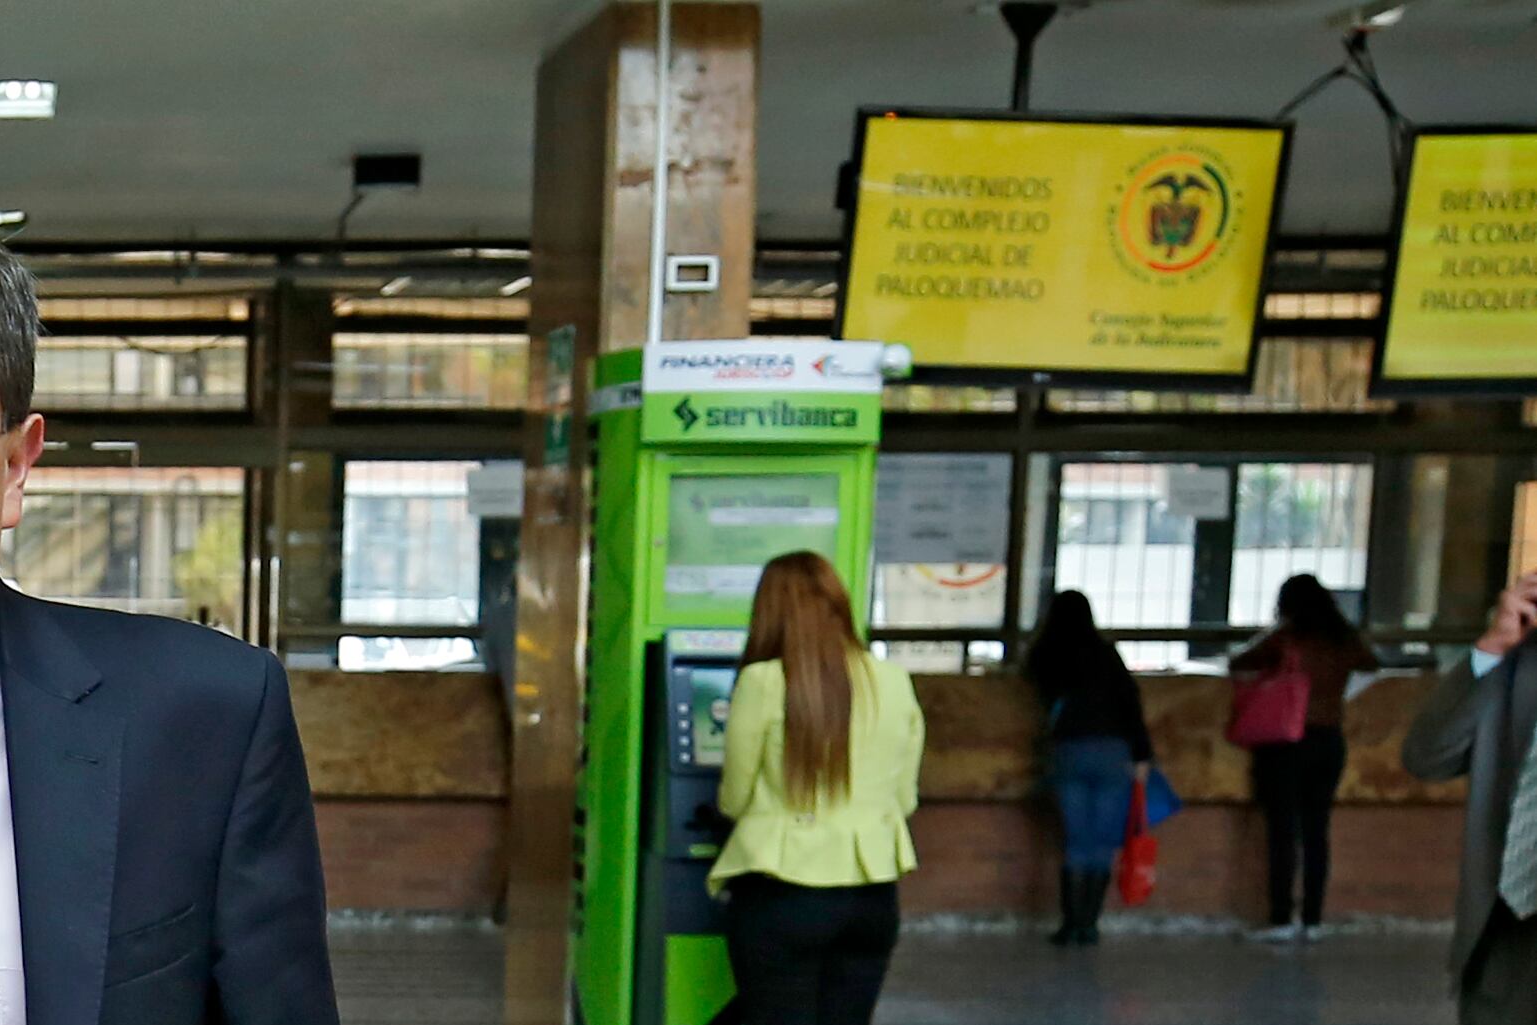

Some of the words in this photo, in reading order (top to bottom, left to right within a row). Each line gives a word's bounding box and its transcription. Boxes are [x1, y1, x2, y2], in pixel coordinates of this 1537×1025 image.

[893, 172, 1053, 200] BIENVENIDOS
[887, 208, 913, 231] AL
[921, 207, 1051, 233] COMPLEJO
[1434, 223, 1459, 244] AL
[893, 241, 994, 267] JUDICIAL
[1001, 244, 1033, 267] DE
[876, 274, 1045, 299] PALOQUEMAO
[1420, 289, 1537, 311] PALOQUE
[706, 399, 858, 427] servibanca
